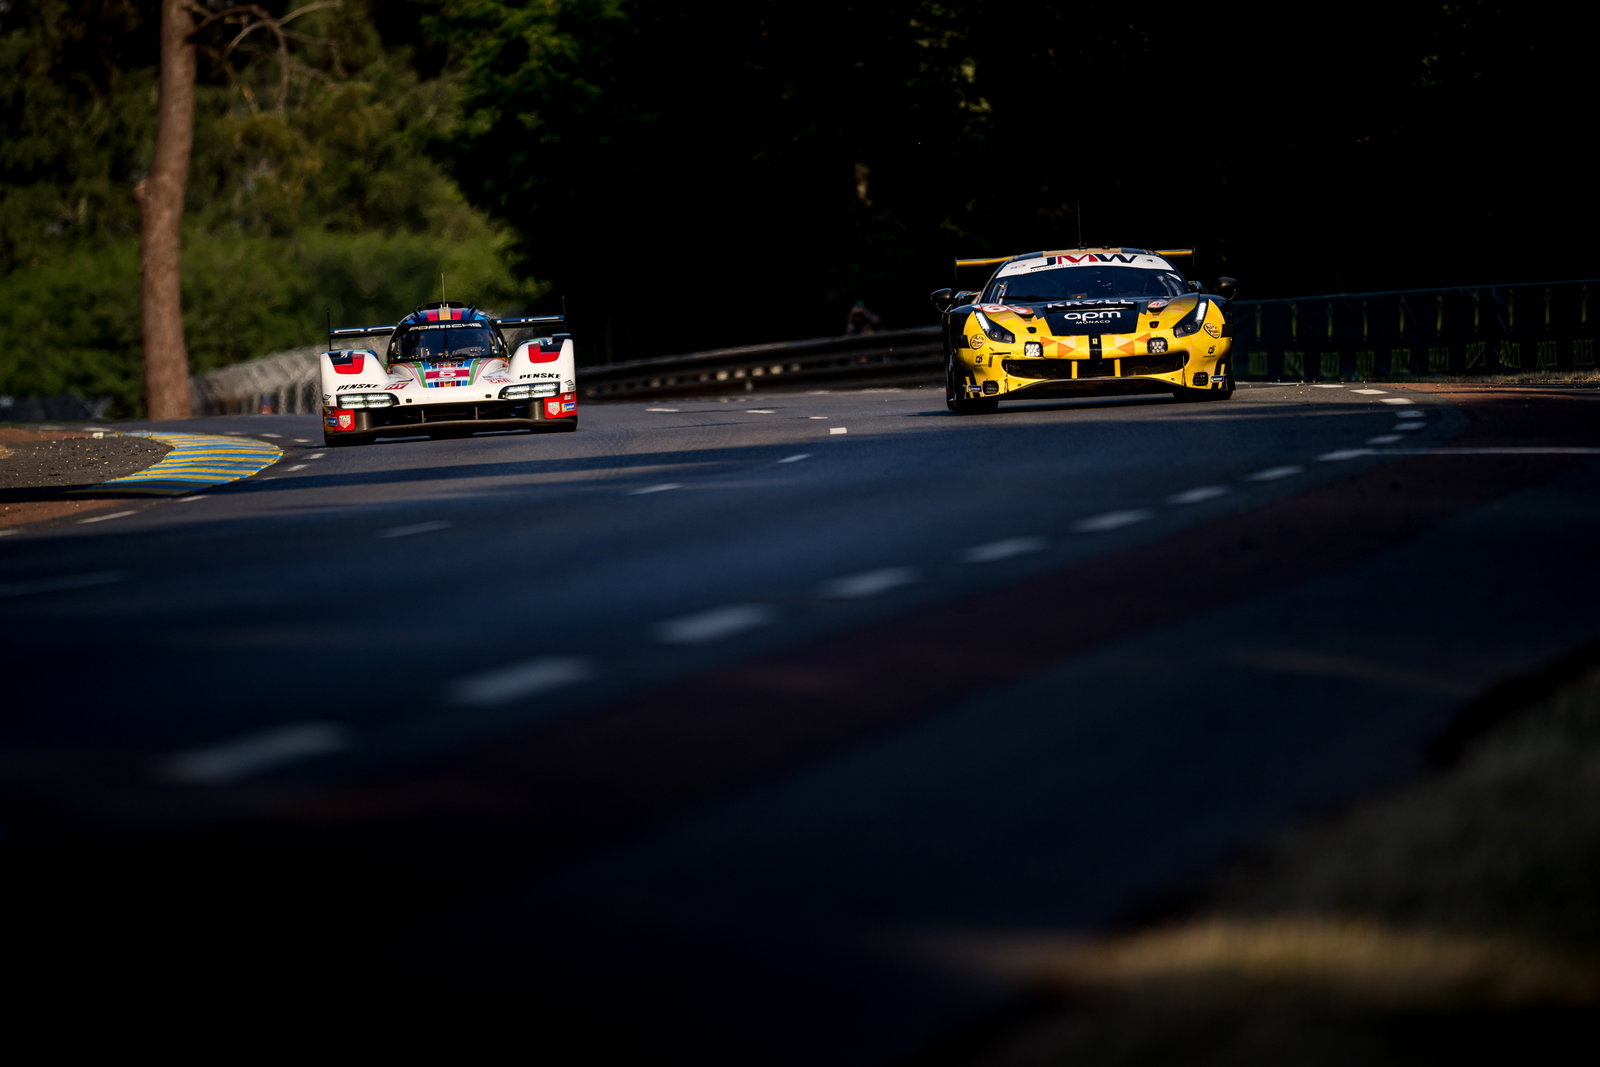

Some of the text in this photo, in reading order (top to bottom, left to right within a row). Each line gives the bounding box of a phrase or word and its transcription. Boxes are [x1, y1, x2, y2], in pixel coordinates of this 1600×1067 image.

[1030, 254, 1137, 269] JMW
[1064, 311, 1121, 321] apm
[409, 323, 482, 331] PORSCHE
